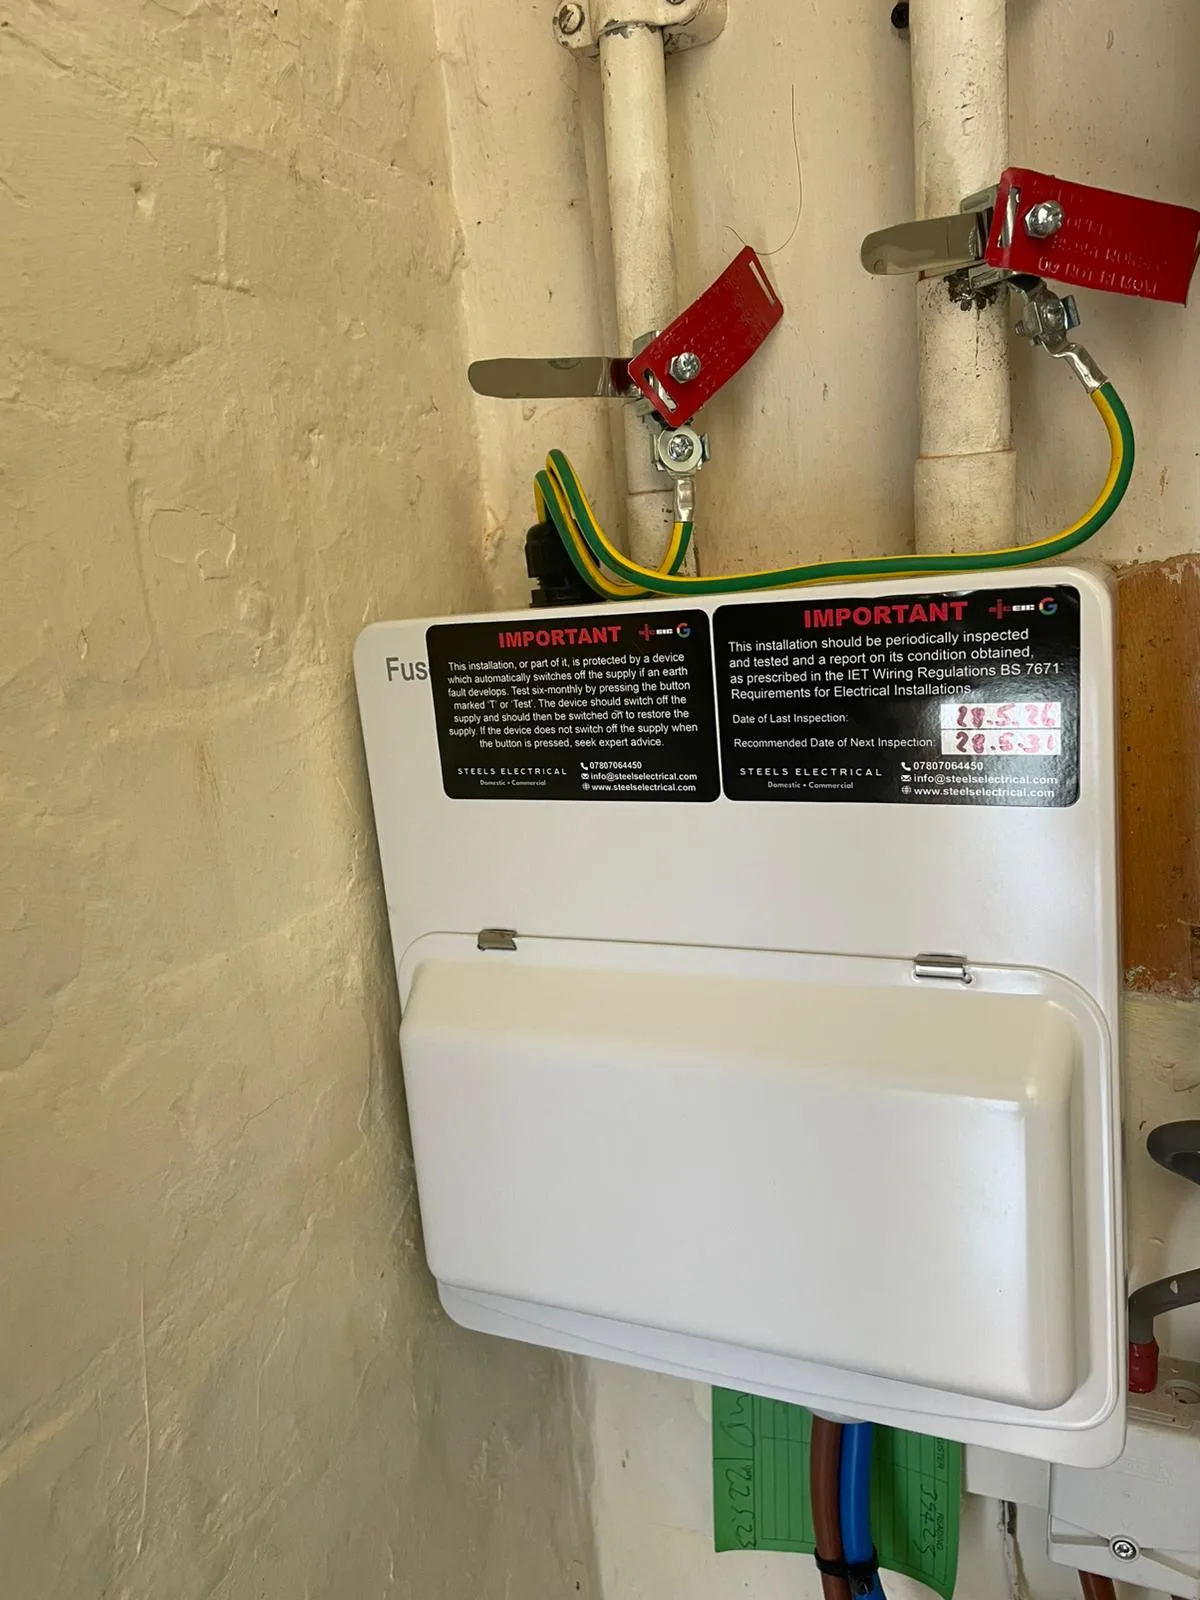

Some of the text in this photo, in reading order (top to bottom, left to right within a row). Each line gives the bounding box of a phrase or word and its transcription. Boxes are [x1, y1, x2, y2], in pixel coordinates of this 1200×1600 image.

[803, 601, 969, 628] IMPORTANT
[498, 625, 622, 649] IMPORTANT
[728, 628, 1029, 652] This installation should be periodically inspected
[448, 661, 466, 671] This
[469, 660, 517, 670] installation,
[519, 661, 528, 669] or
[531, 659, 548, 670] part
[550, 658, 559, 667] of
[561, 658, 570, 667] it,
[573, 657, 580, 666] is
[583, 655, 626, 667] protected
[629, 654, 640, 666] by
[652, 652, 684, 662] device
[729, 646, 1034, 668] and tested and a report on its condition obtained,
[448, 675, 472, 683] which
[475, 673, 531, 683] automatically
[534, 672, 571, 681] switches
[574, 670, 586, 679] off
[589, 670, 603, 679] the
[606, 669, 636, 680] supply
[640, 667, 645, 677] if
[663, 666, 688, 676] earth
[730, 674, 743, 684] as
[747, 671, 807, 686] prescribed
[811, 671, 821, 682] in
[825, 670, 843, 681] the
[848, 669, 869, 680] IET
[874, 667, 913, 681] Wiring
[918, 666, 996, 680] Regulations
[1001, 664, 1021, 676] BS
[448, 682, 690, 697] fault develops. Test six-monthly by pressing the button
[731, 688, 810, 701] Requirements
[815, 686, 830, 697] for
[834, 685, 889, 697] Electrical
[454, 701, 485, 710] marked
[500, 701, 508, 709] or
[538, 698, 555, 707] The
[558, 698, 587, 707] device
[590, 697, 621, 706] should
[624, 696, 653, 705] switch
[656, 695, 668, 704] off
[671, 695, 687, 704] the
[454, 709, 689, 724] supply and should then be switched on to restore the
[732, 713, 848, 724] Date of Last Inspection:
[449, 723, 698, 737] supply. If the device does not switch off the supply when
[480, 739, 493, 748] the
[495, 739, 522, 747] button
[525, 739, 531, 747] is
[575, 738, 596, 747] seek
[599, 739, 628, 748] expert
[631, 737, 664, 746] advice.
[734, 738, 807, 747] Recommended
[810, 738, 834, 747] Date
[837, 738, 848, 747] of
[851, 738, 874, 747] Next
[740, 768, 882, 776] STEELS ELECTRICAL
[913, 761, 983, 771] 07807064450
[591, 772, 697, 781] info@steelselectrical.com
[914, 774, 1058, 785] info@steelselectrical.com
[592, 783, 696, 791] www.steelselectrical.com
[914, 787, 1055, 798] www.steelselectrical.com
